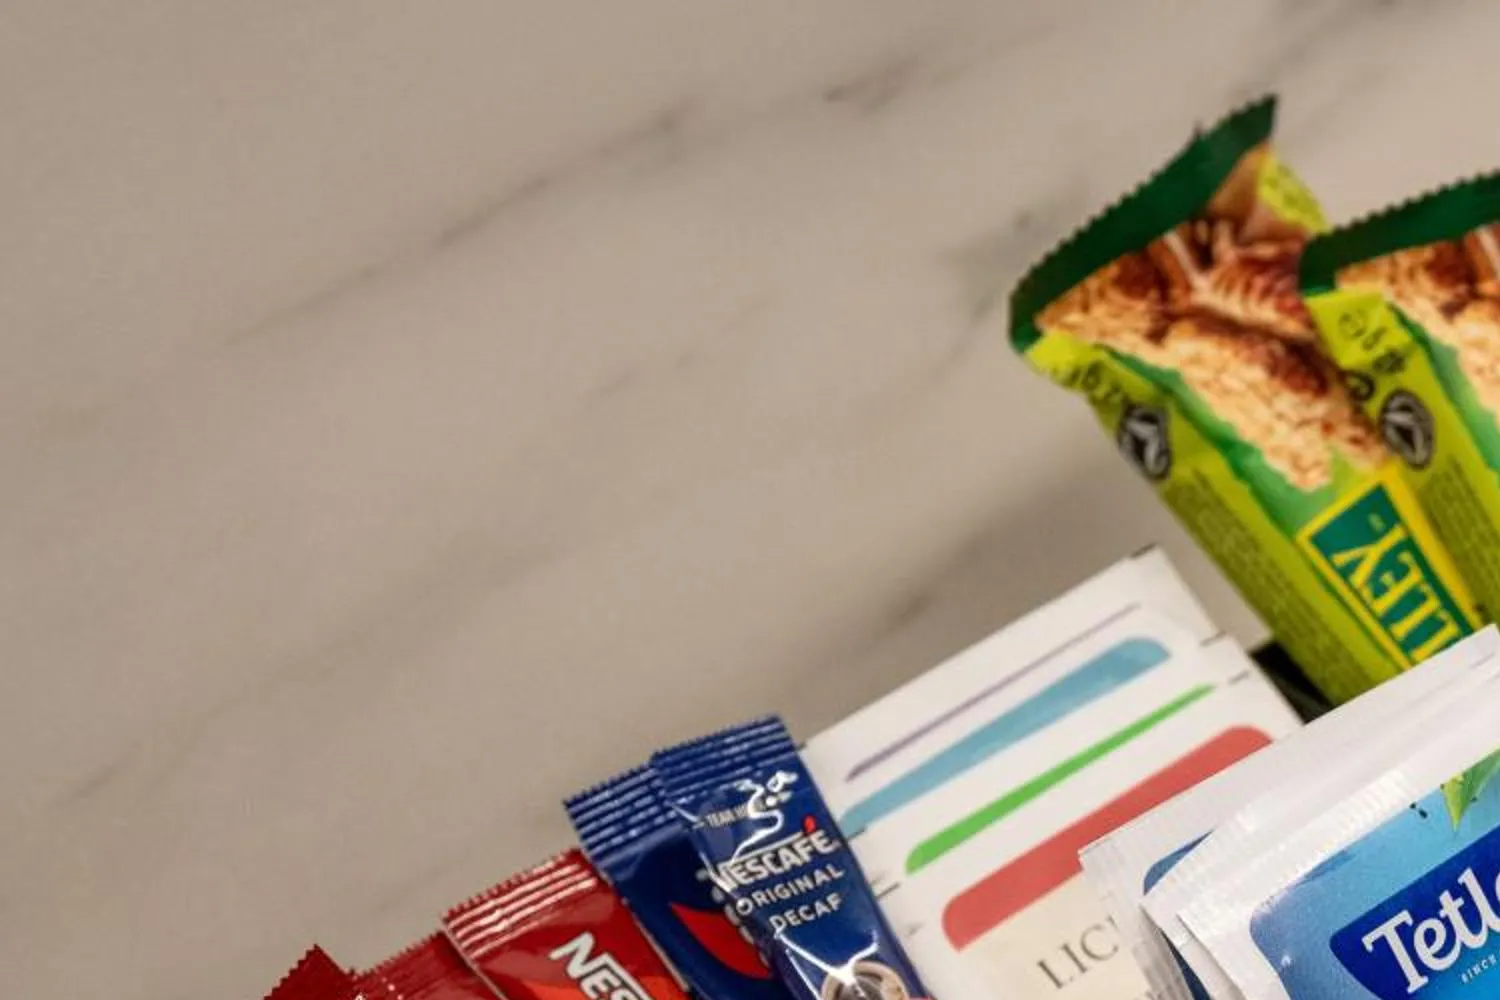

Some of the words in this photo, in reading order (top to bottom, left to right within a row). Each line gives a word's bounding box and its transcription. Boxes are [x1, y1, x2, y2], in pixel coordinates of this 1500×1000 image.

[738, 863, 844, 916] ORIGINAL
[769, 893, 843, 935] DECAF
[1037, 914, 1121, 989] LIC
